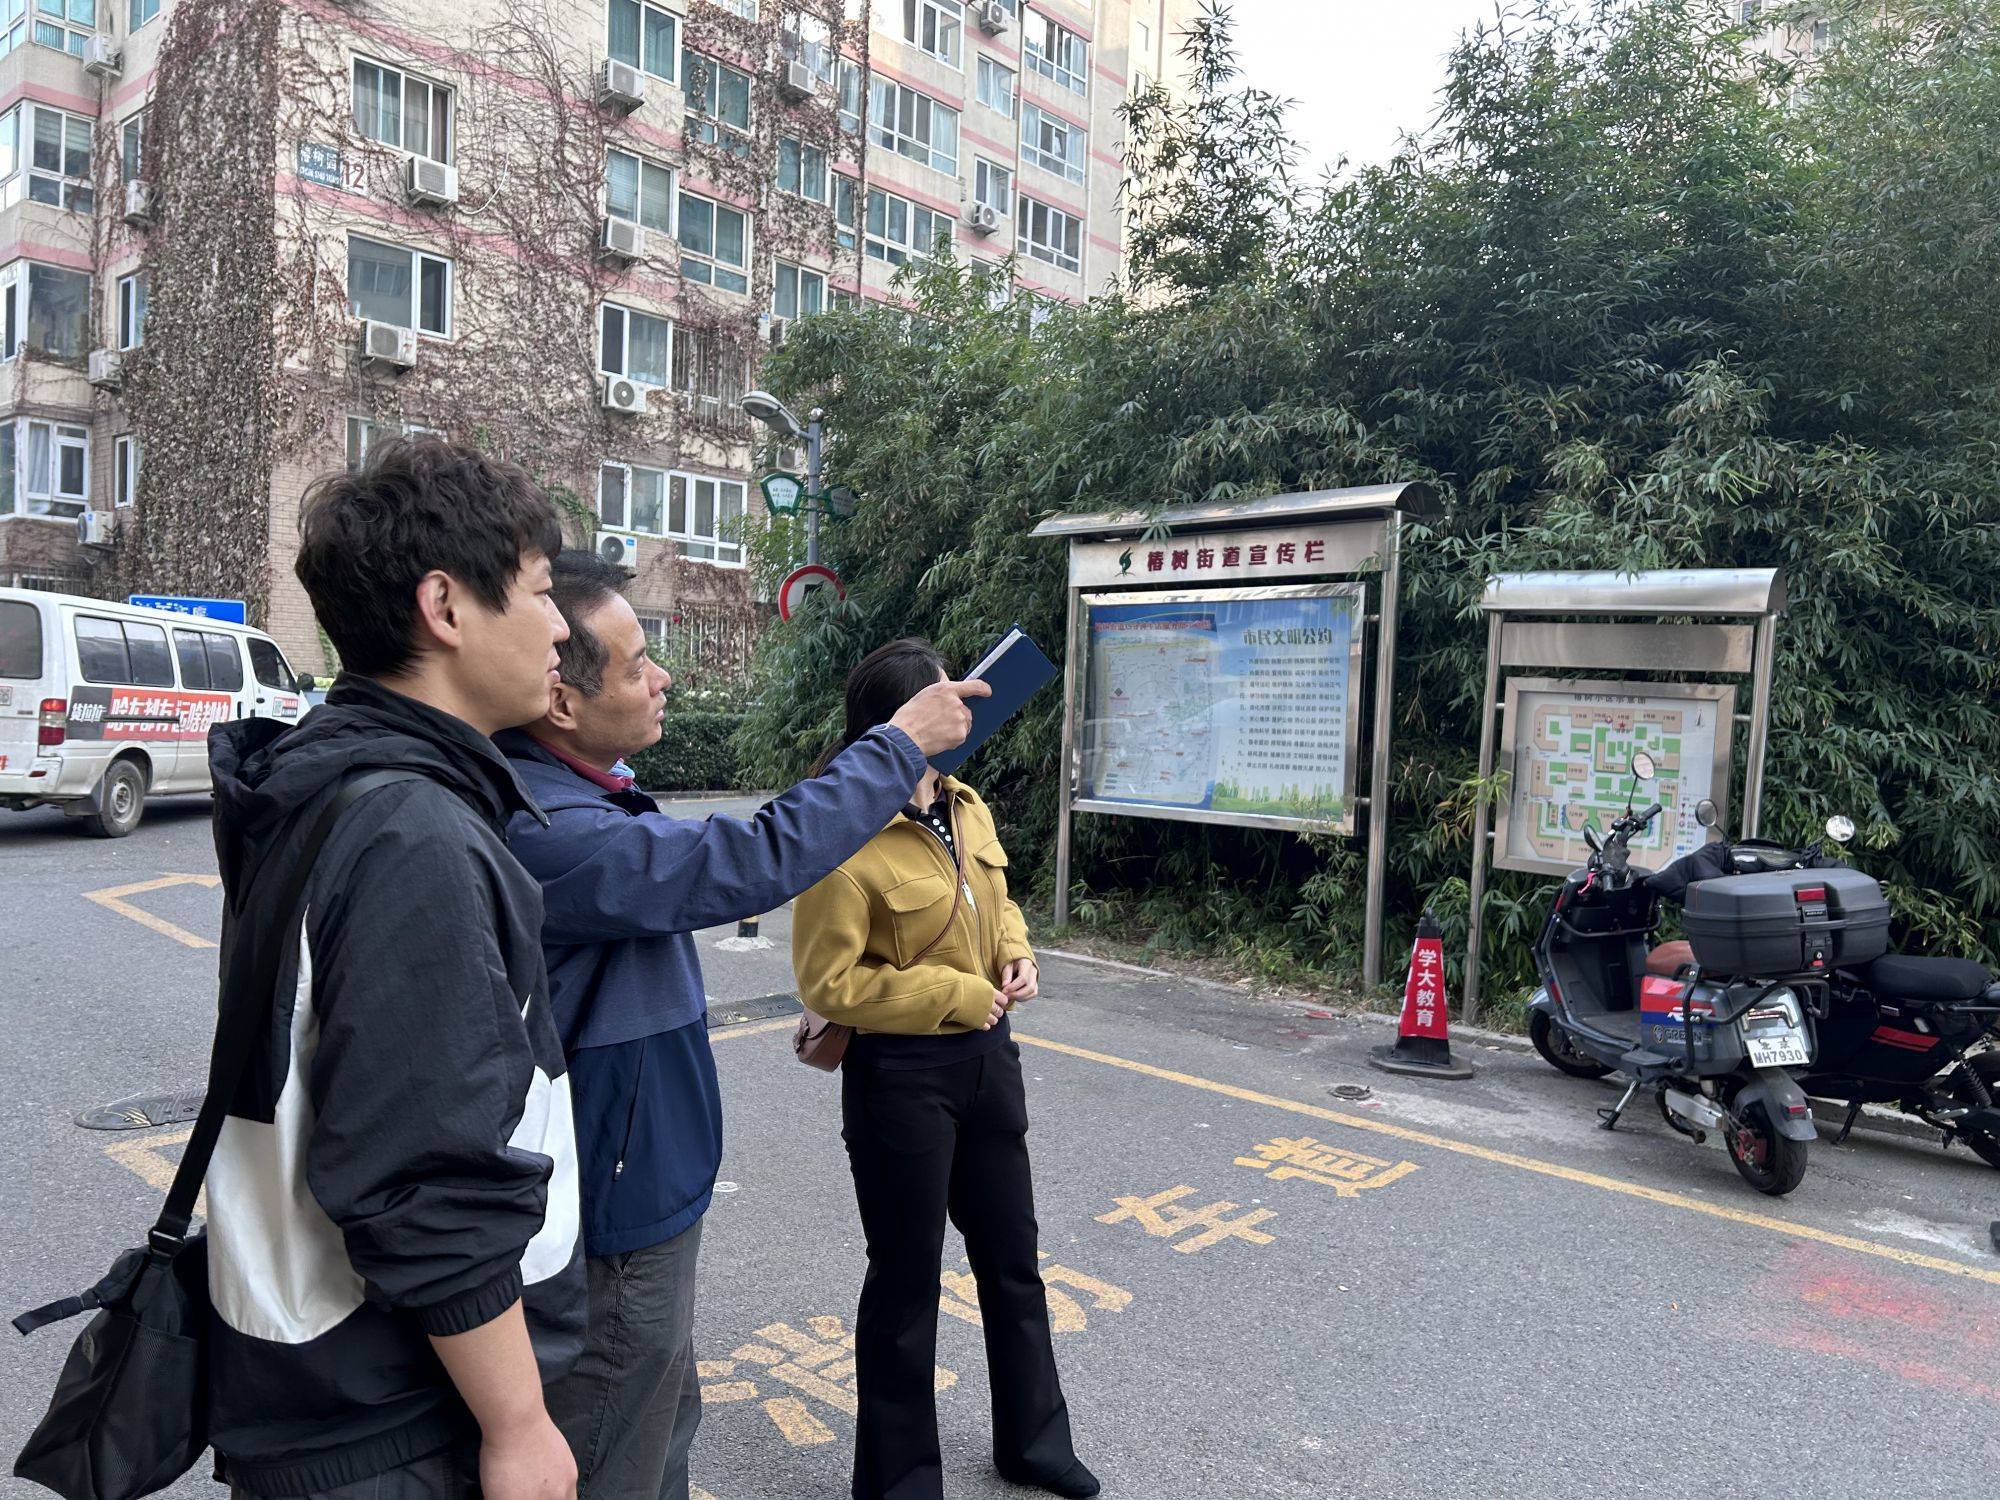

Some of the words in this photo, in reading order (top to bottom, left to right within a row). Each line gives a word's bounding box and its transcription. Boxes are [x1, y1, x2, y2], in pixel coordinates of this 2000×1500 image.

[343, 160, 364, 189] 12
[1147, 540, 1325, 572] 椿树街道宣传栏
[1243, 627, 1332, 646] 市民文明公约
[70, 703, 106, 722] 货拉拉
[1416, 949, 1437, 1028] 学大教育
[1754, 1050, 1803, 1064] MH7930
